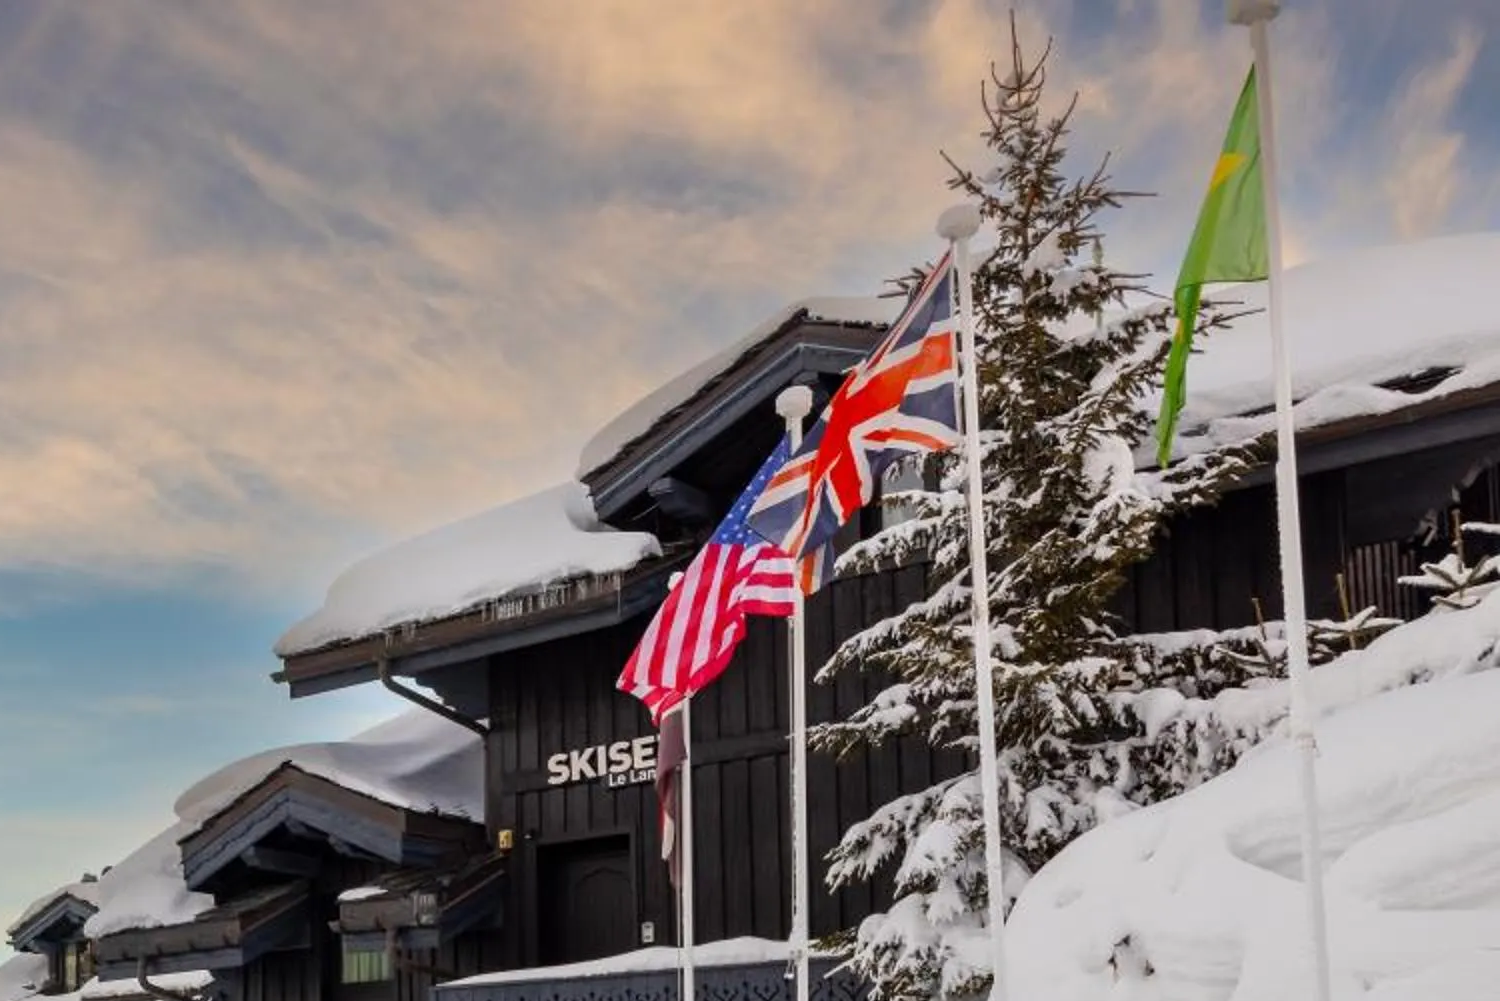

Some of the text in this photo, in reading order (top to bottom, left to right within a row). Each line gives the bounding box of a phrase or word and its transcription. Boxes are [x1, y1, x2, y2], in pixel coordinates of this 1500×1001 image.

[547, 734, 660, 785] SKISE
[608, 768, 657, 787] Le Lan
